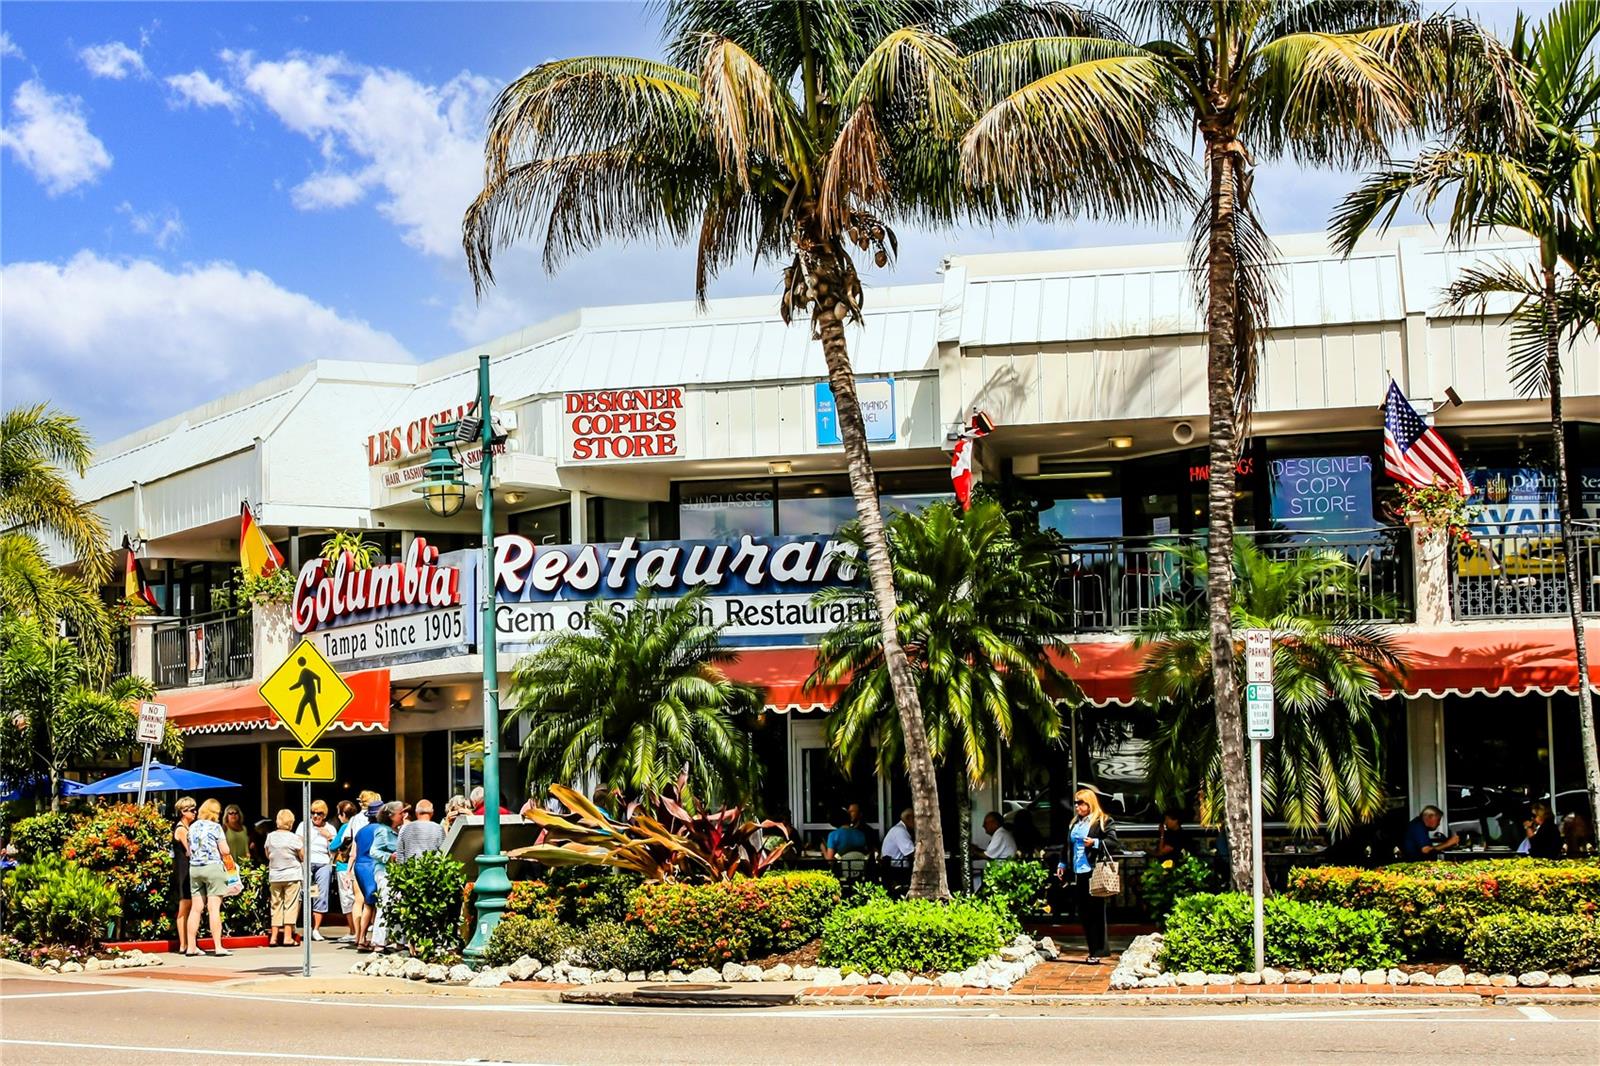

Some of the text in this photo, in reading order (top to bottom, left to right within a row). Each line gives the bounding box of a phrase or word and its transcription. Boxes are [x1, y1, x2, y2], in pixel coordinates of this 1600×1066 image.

[565, 388, 683, 413] DESIGNER
[861, 400, 888, 411] MANDS
[572, 411, 676, 435] COPIES
[368, 427, 401, 467] LES
[573, 434, 677, 459] STORE
[1272, 456, 1372, 477] DESIGNER
[385, 473, 401, 486] HAIR
[1296, 477, 1351, 495] COPY
[681, 492, 771, 511] SUNGLASSES
[1291, 496, 1357, 515] STORE
[292, 534, 859, 633] Columbia Restauran
[496, 605, 555, 633] Gem
[568, 601, 591, 631] of
[609, 601, 713, 627] Spansh
[323, 611, 462, 659] Tampa Since 1905
[1254, 634, 1264, 643] NO
[1249, 647, 1270, 657] PARKING
[1249, 686, 1256, 699] 3
[141, 714, 163, 724] PARKING
[148, 706, 158, 715] NO
